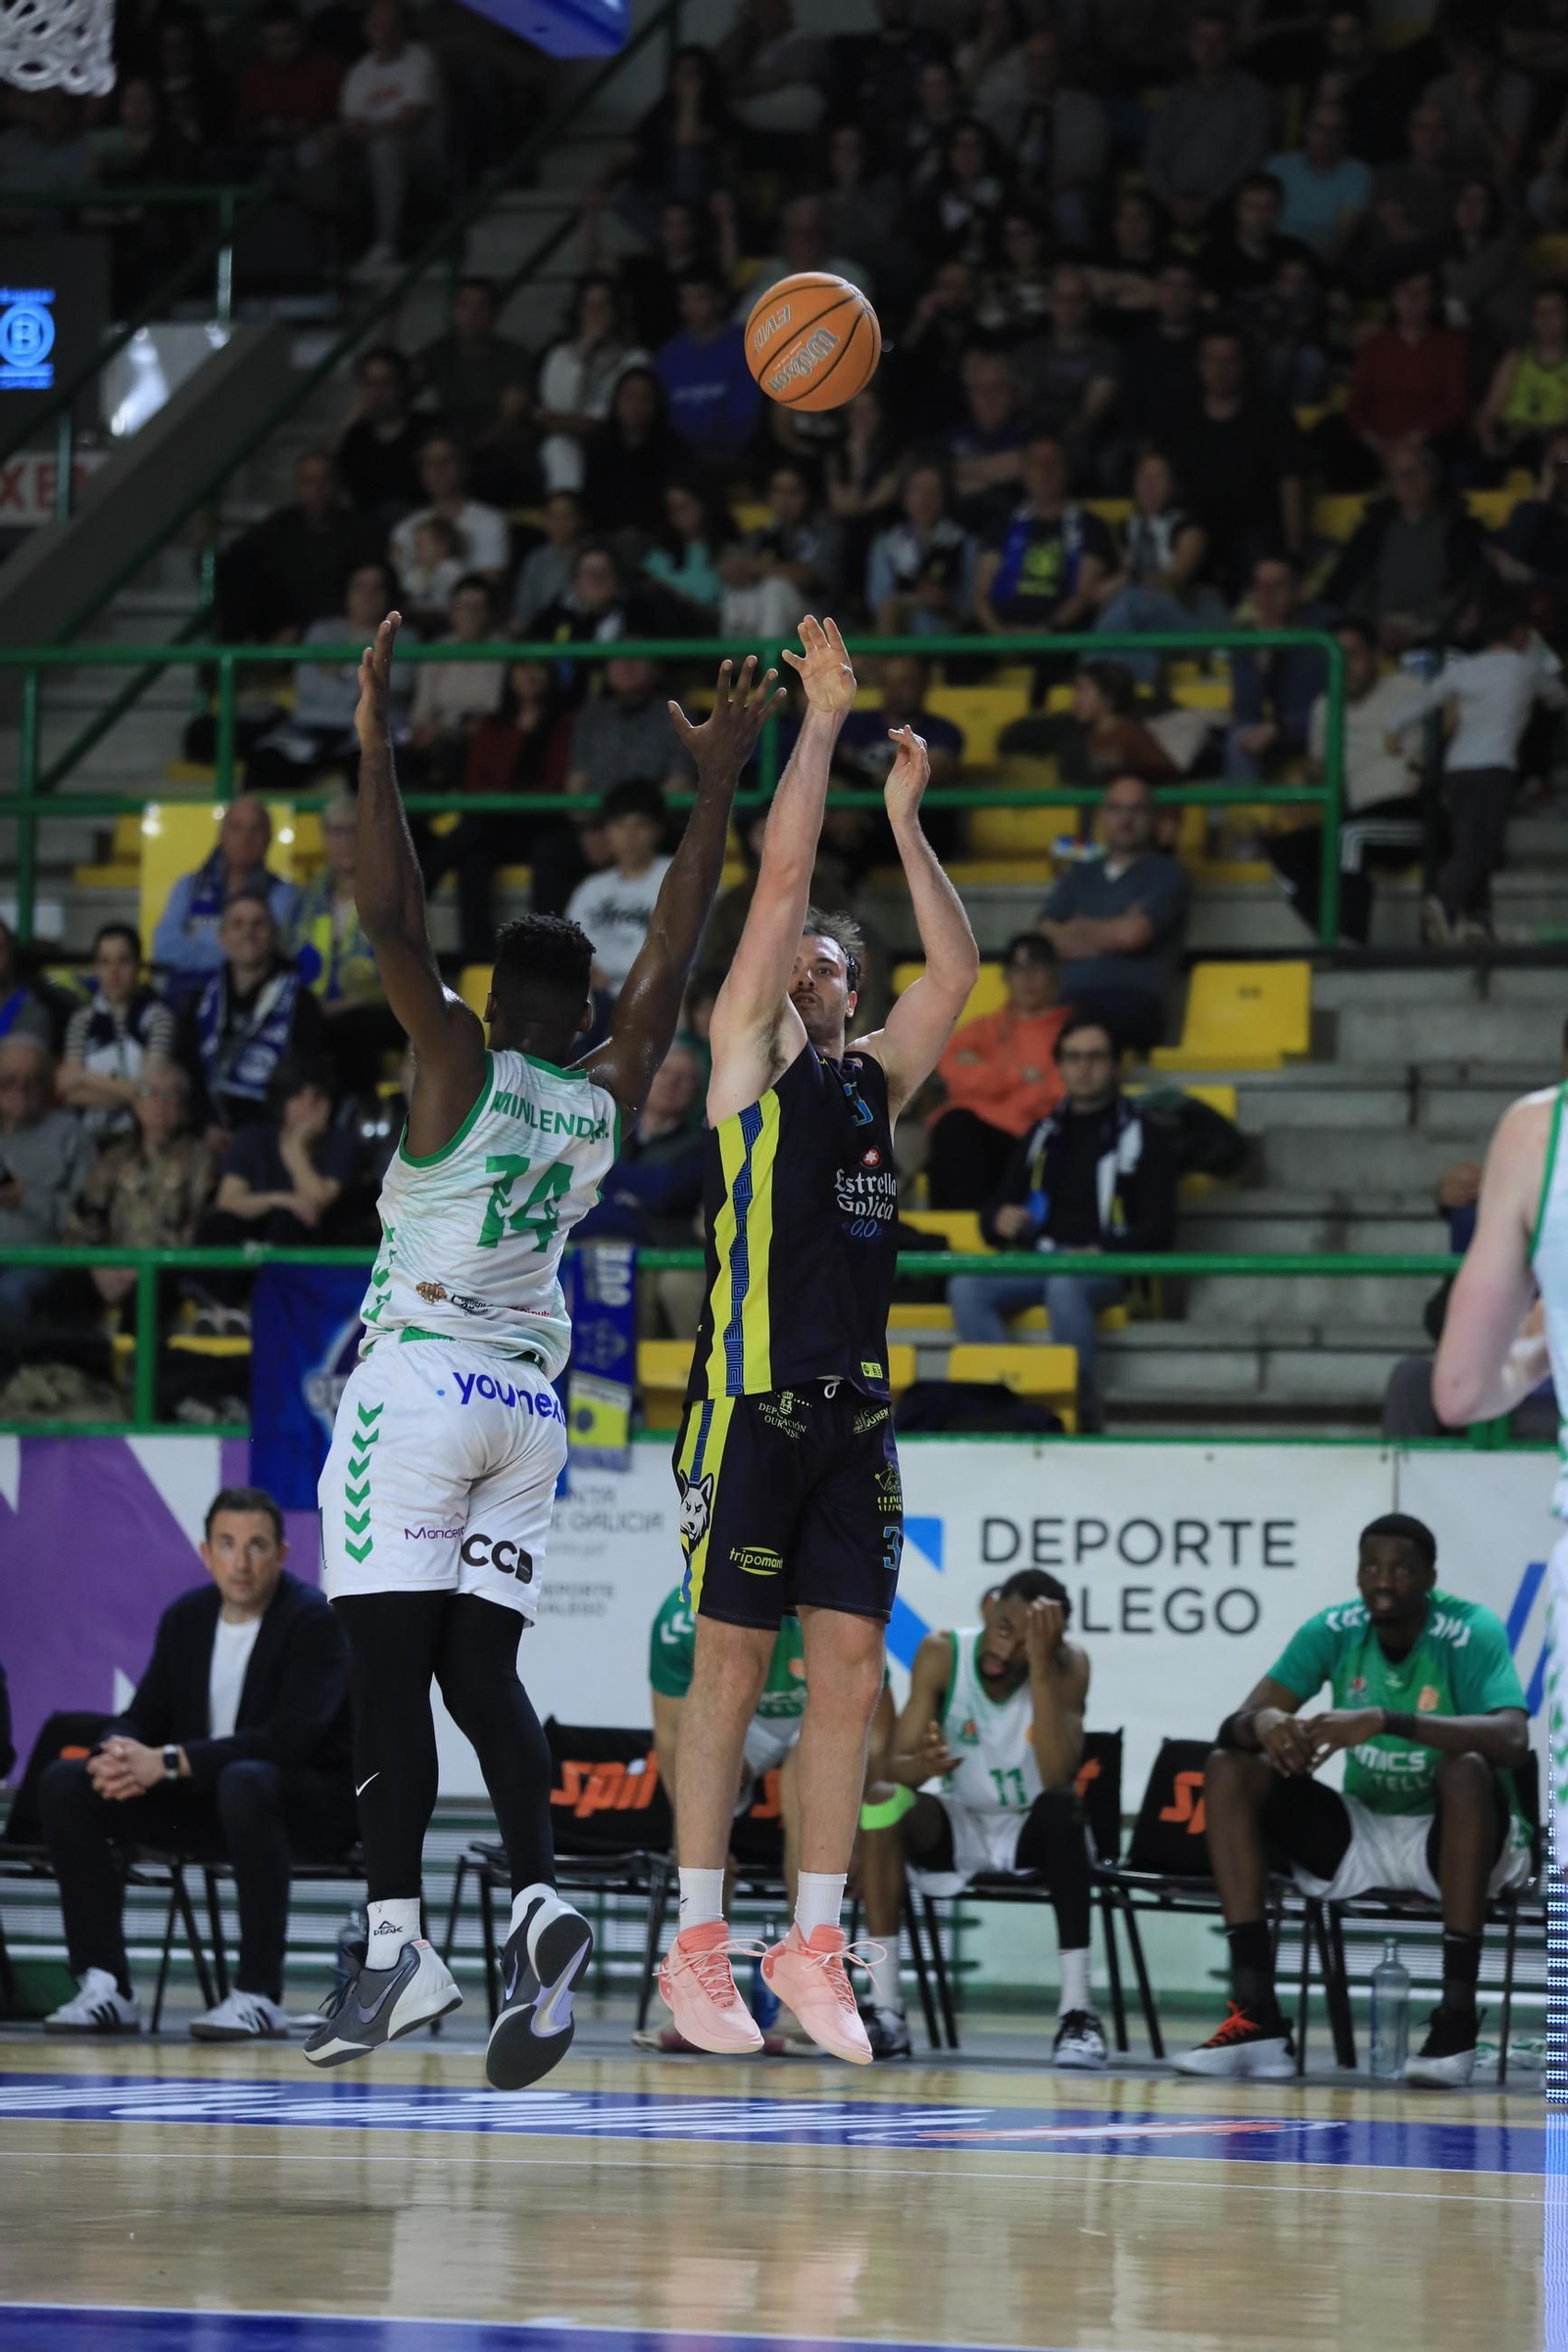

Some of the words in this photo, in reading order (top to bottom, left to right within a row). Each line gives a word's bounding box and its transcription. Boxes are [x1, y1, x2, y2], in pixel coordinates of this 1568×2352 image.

[766, 327, 841, 393] Wilson
[490, 1090, 594, 1139] MINLEND
[834, 1168, 897, 1196] Estrella
[836, 1193, 894, 1221] Galicia
[883, 1526, 902, 1571] 3
[982, 1517, 1296, 1568] DEPORTE
[1066, 1585, 1261, 1635] LEGO
[989, 1766, 1028, 1807] 11
[373, 1925, 404, 1936] PEAK
